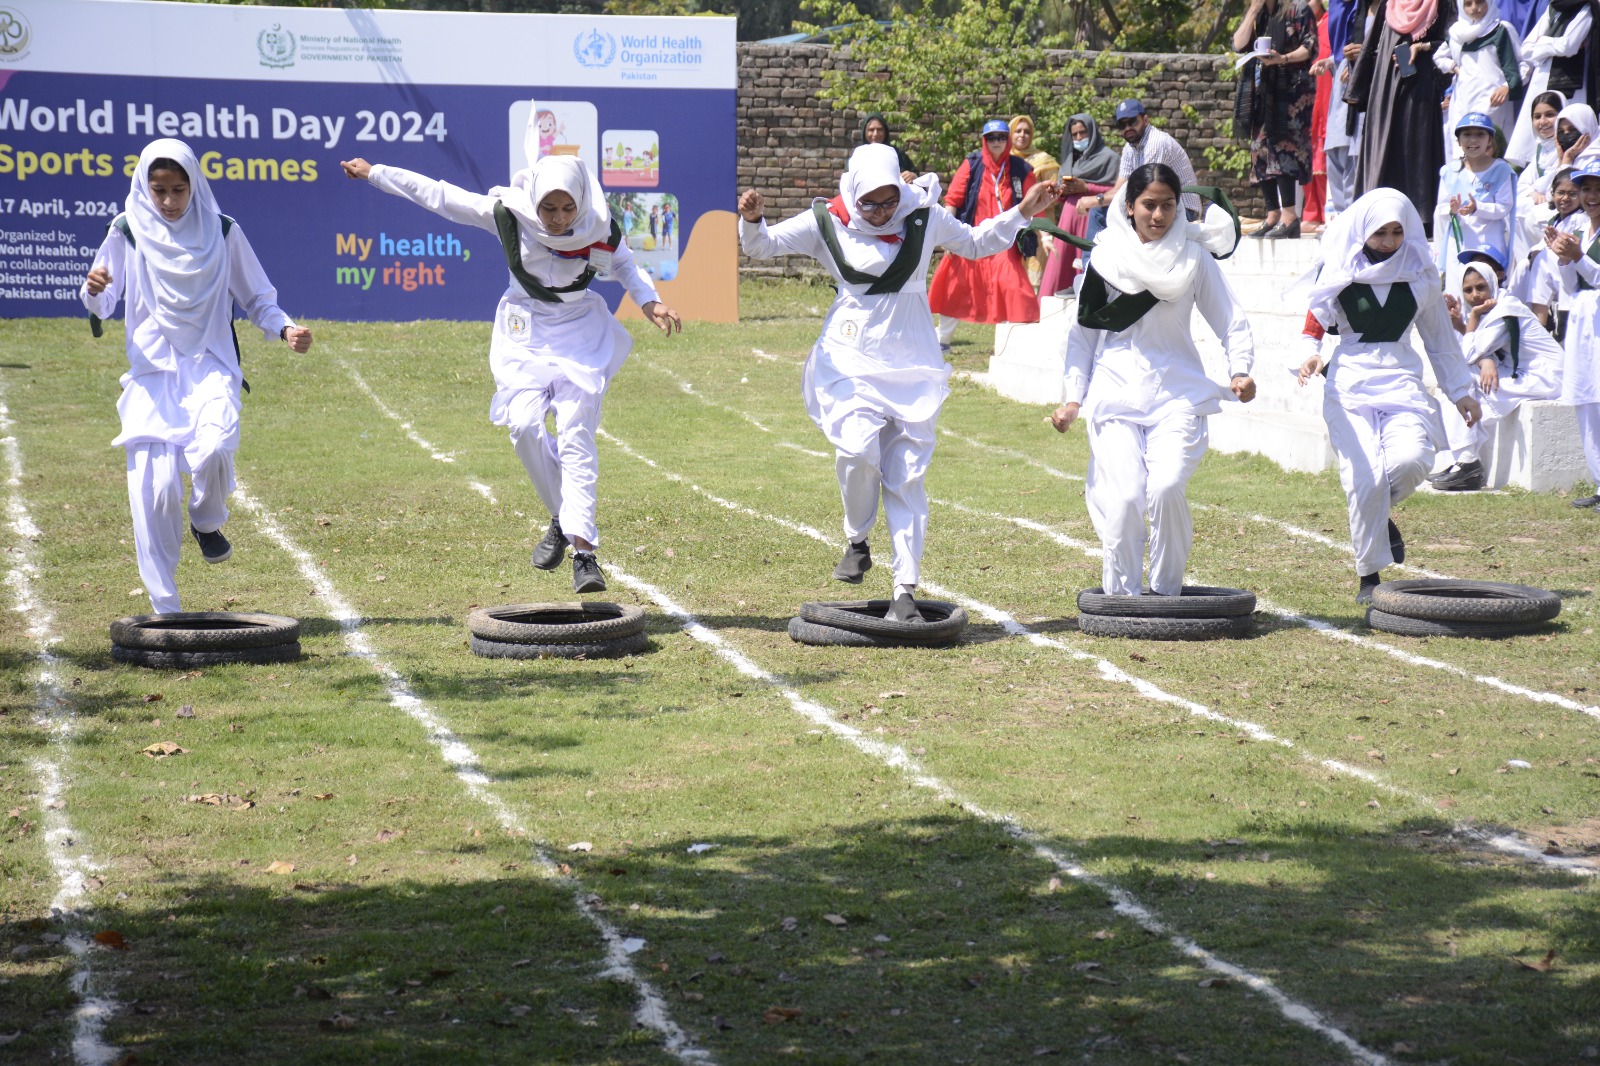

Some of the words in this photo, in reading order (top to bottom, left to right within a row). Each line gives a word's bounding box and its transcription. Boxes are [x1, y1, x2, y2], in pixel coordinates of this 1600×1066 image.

[300, 35, 331, 44] Ministry
[343, 36, 375, 44] National
[621, 35, 657, 48] World
[662, 36, 702, 49] Health
[300, 53, 353, 61] GOVERNMENT
[621, 50, 702, 66] Organization
[621, 72, 657, 80] Pakistan
[0, 98, 114, 135] World
[127, 103, 259, 139] Health
[272, 107, 346, 149] Day
[355, 110, 448, 142] 2024
[0, 143, 113, 181] Sports
[200, 151, 318, 182] Games
[19, 198, 71, 218] April,
[74, 201, 119, 216] 2024
[58, 230, 76, 244] by:
[36, 245, 77, 256] Health
[336, 233, 373, 261] My
[380, 232, 471, 262] health,
[10, 259, 89, 271] collaboration
[45, 274, 87, 286] Health
[336, 266, 376, 290] my
[383, 261, 446, 291] right
[53, 288, 77, 300] Girl
